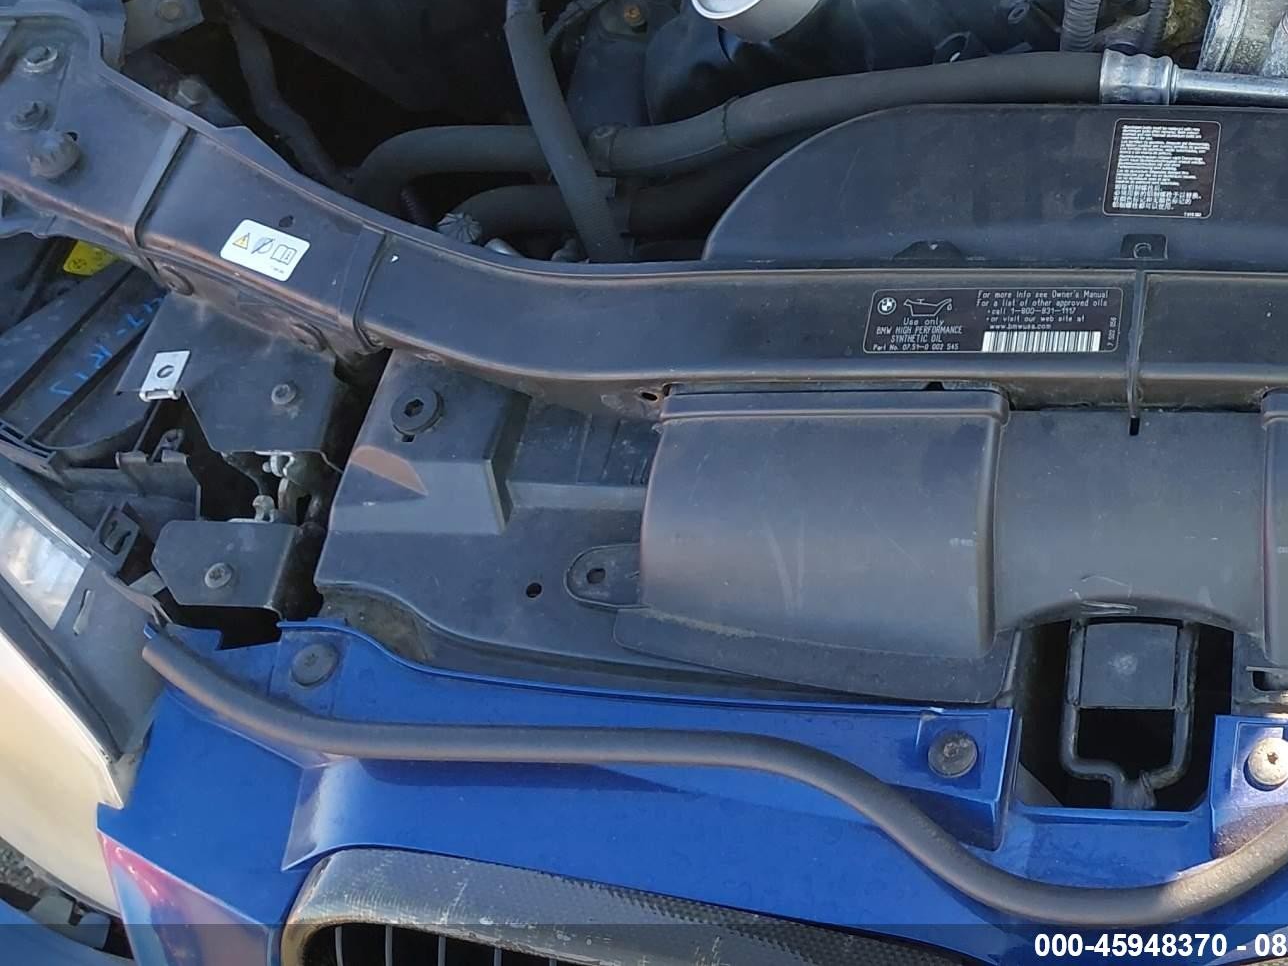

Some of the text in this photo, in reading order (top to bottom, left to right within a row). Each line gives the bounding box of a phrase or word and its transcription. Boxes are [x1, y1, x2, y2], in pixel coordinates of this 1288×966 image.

[977, 290, 993, 298] For
[1052, 290, 1080, 298] Owner's
[1083, 290, 1109, 298] Manual
[976, 298, 989, 307] For
[1002, 298, 1016, 307] list
[1020, 298, 1028, 307] of
[1032, 298, 1052, 307] other
[1056, 298, 1089, 308] approved
[1093, 298, 1108, 307] oils
[992, 307, 1006, 315] call
[903, 316, 945, 327] Use only
[876, 326, 963, 335] BMW HIGH PERFORMANCE
[890, 334, 943, 343] SYNTHETIC OIL
